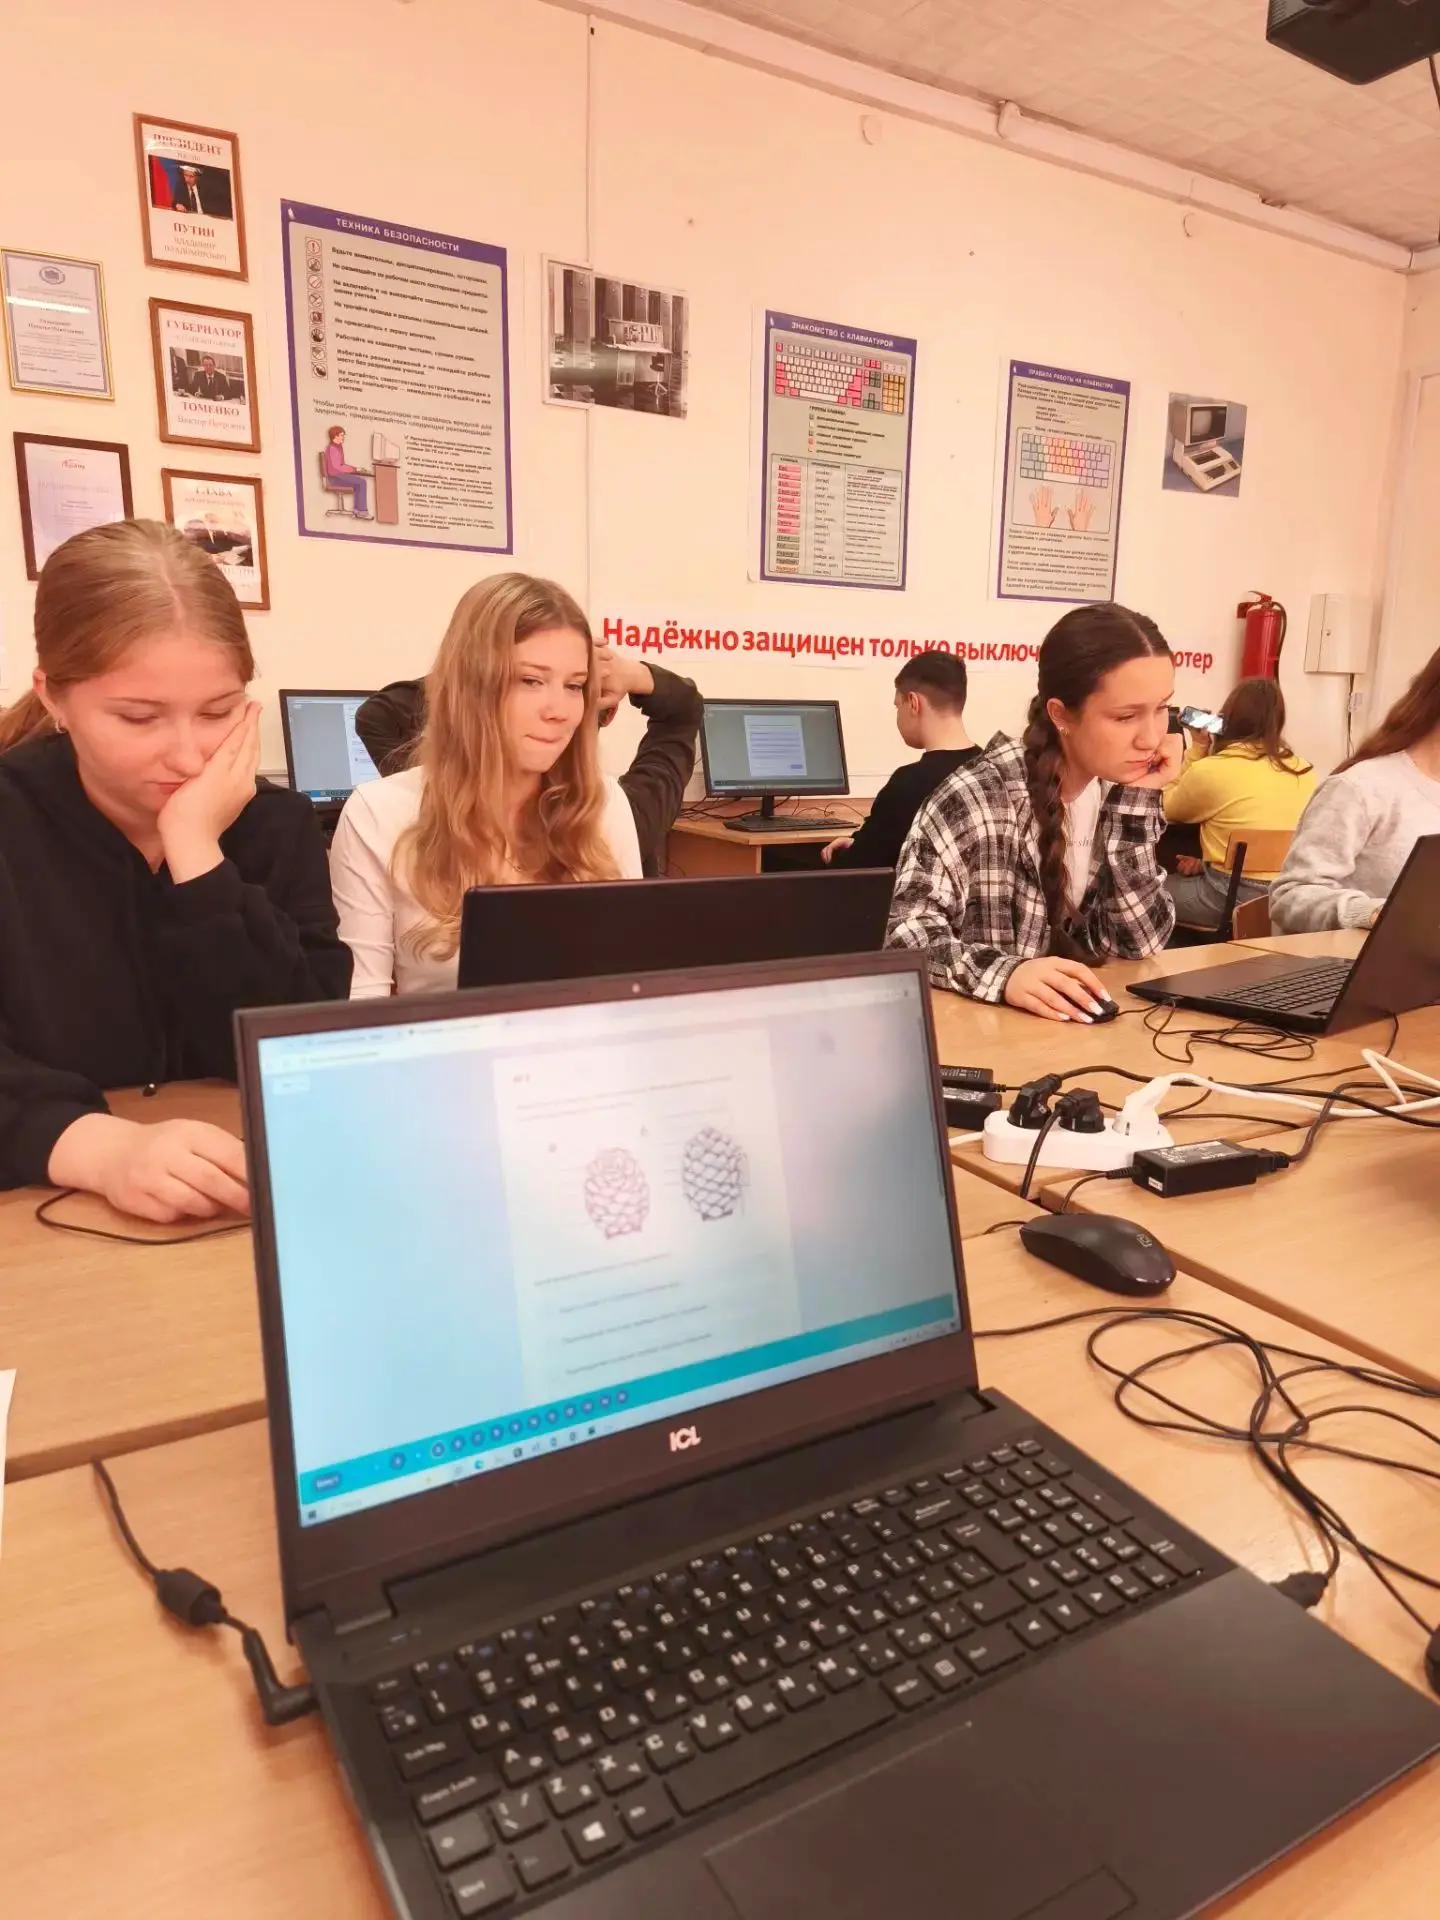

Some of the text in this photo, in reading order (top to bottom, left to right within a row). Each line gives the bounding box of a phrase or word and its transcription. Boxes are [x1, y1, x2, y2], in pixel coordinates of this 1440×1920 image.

[173, 222, 215, 238] ПУТИН
[336, 217, 460, 253] ТЕХНИКА БЕЗОПАСНОСТИ
[166, 319, 242, 339] ГУБЕРНАТОР
[792, 321, 894, 348] ЗНАКОМСТВО С КЛАВИАТУРОЙ
[182, 401, 240, 417] ТОМЕНКО
[603, 617, 739, 653] Надёжно
[742, 630, 864, 660] защищен
[956, 641, 1042, 662] выключ
